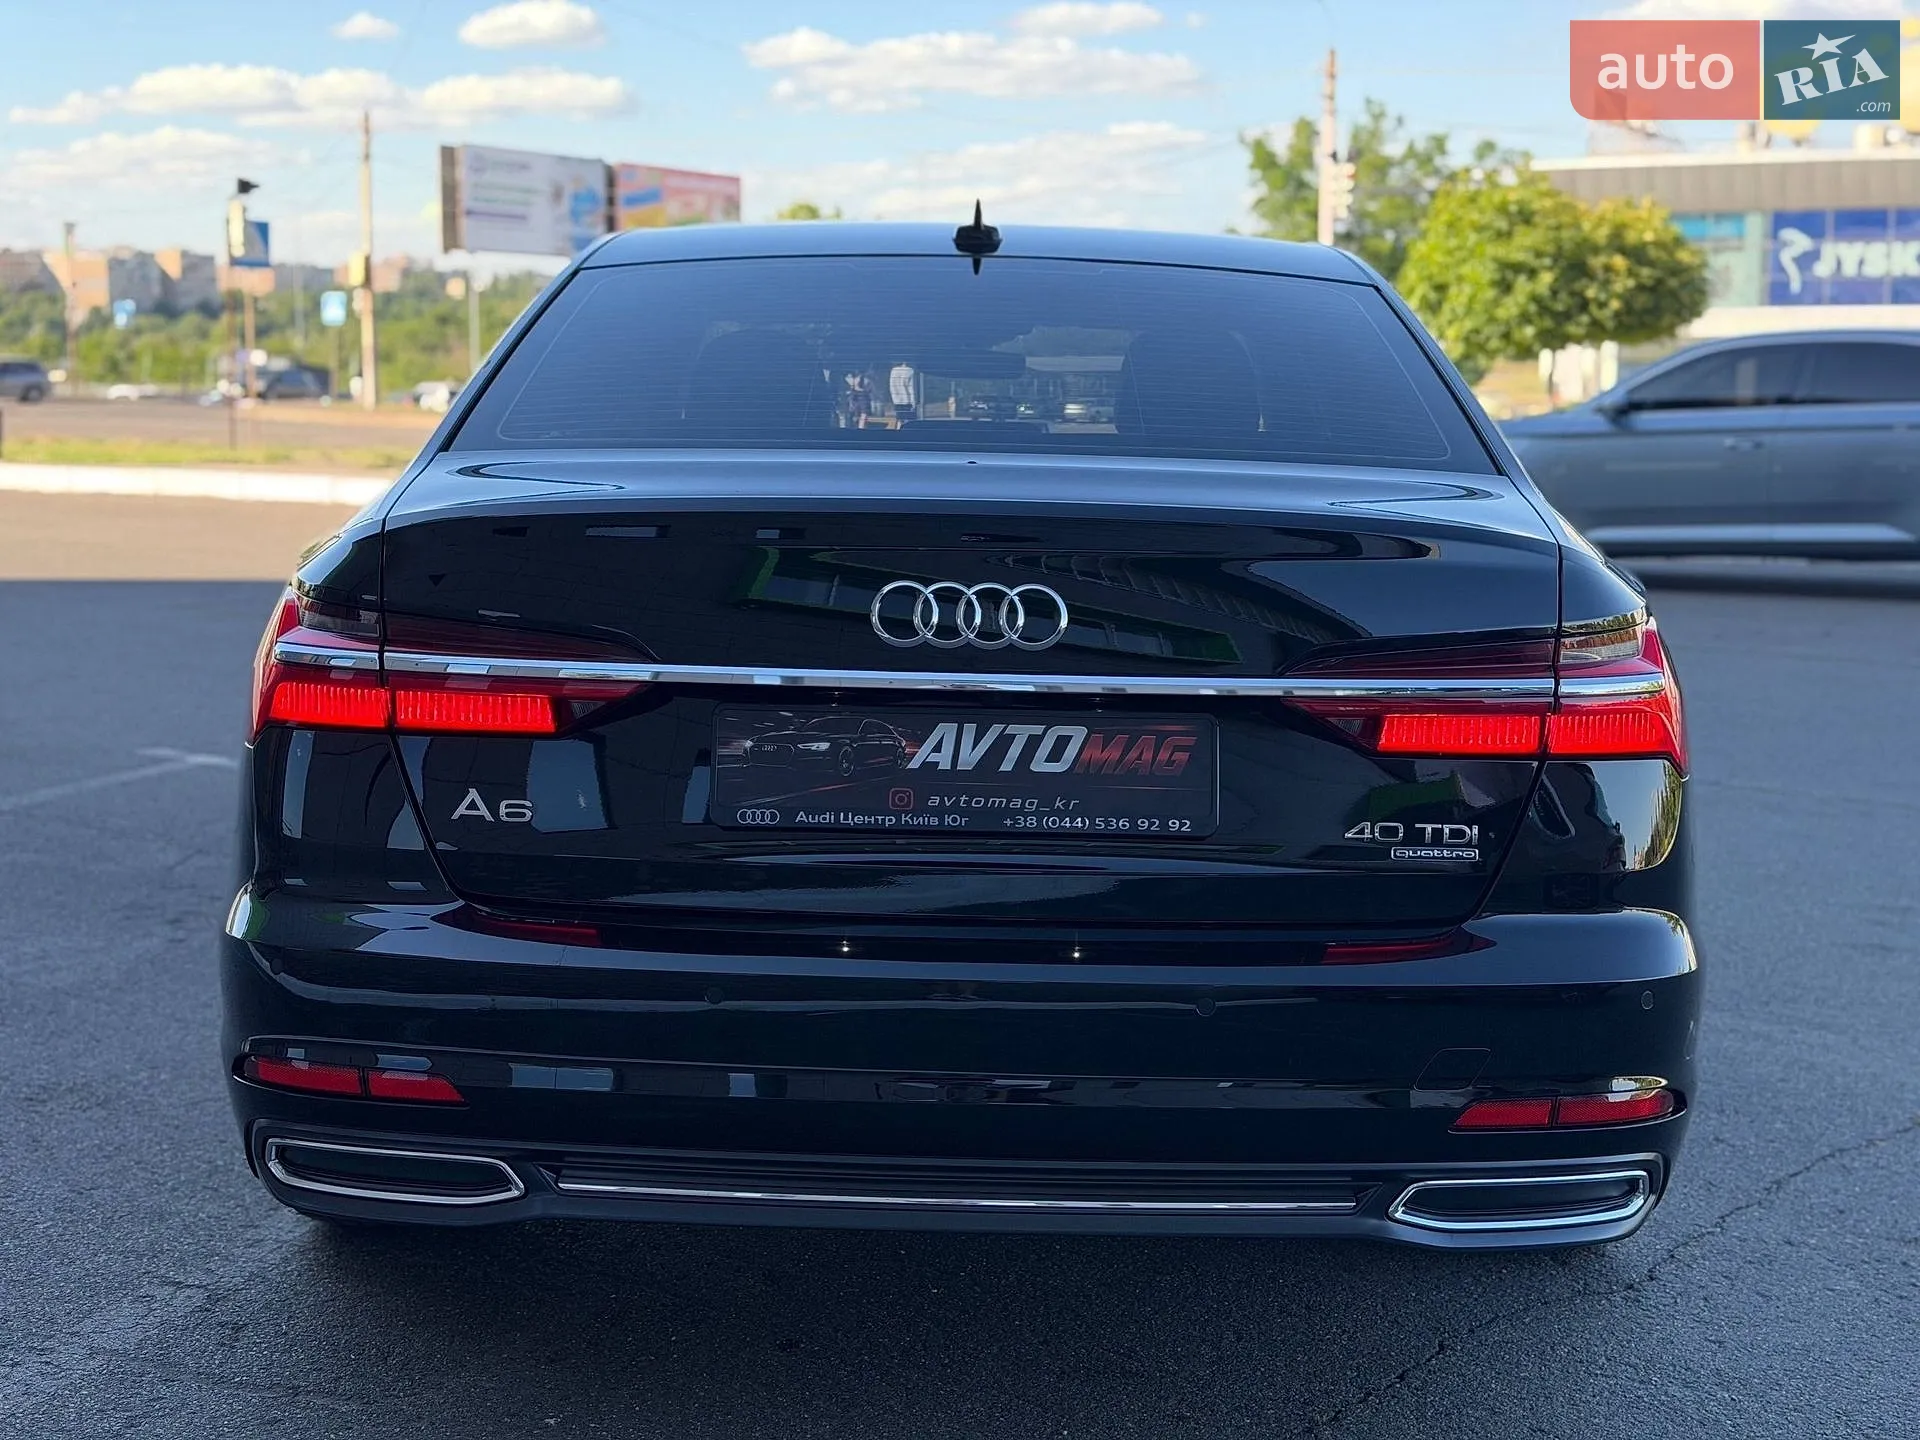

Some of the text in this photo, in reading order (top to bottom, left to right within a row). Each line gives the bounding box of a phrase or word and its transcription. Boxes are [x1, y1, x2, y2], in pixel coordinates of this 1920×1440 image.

[450, 788, 533, 822] A6
[926, 794, 1080, 812] avtomag_kr
[795, 811, 970, 827] Audi Центр Київ Юг
[1003, 815, 1192, 832] +38 (044) 536 92 92
[1344, 822, 1479, 845] 40 TDI
[1395, 849, 1476, 859] quattro
